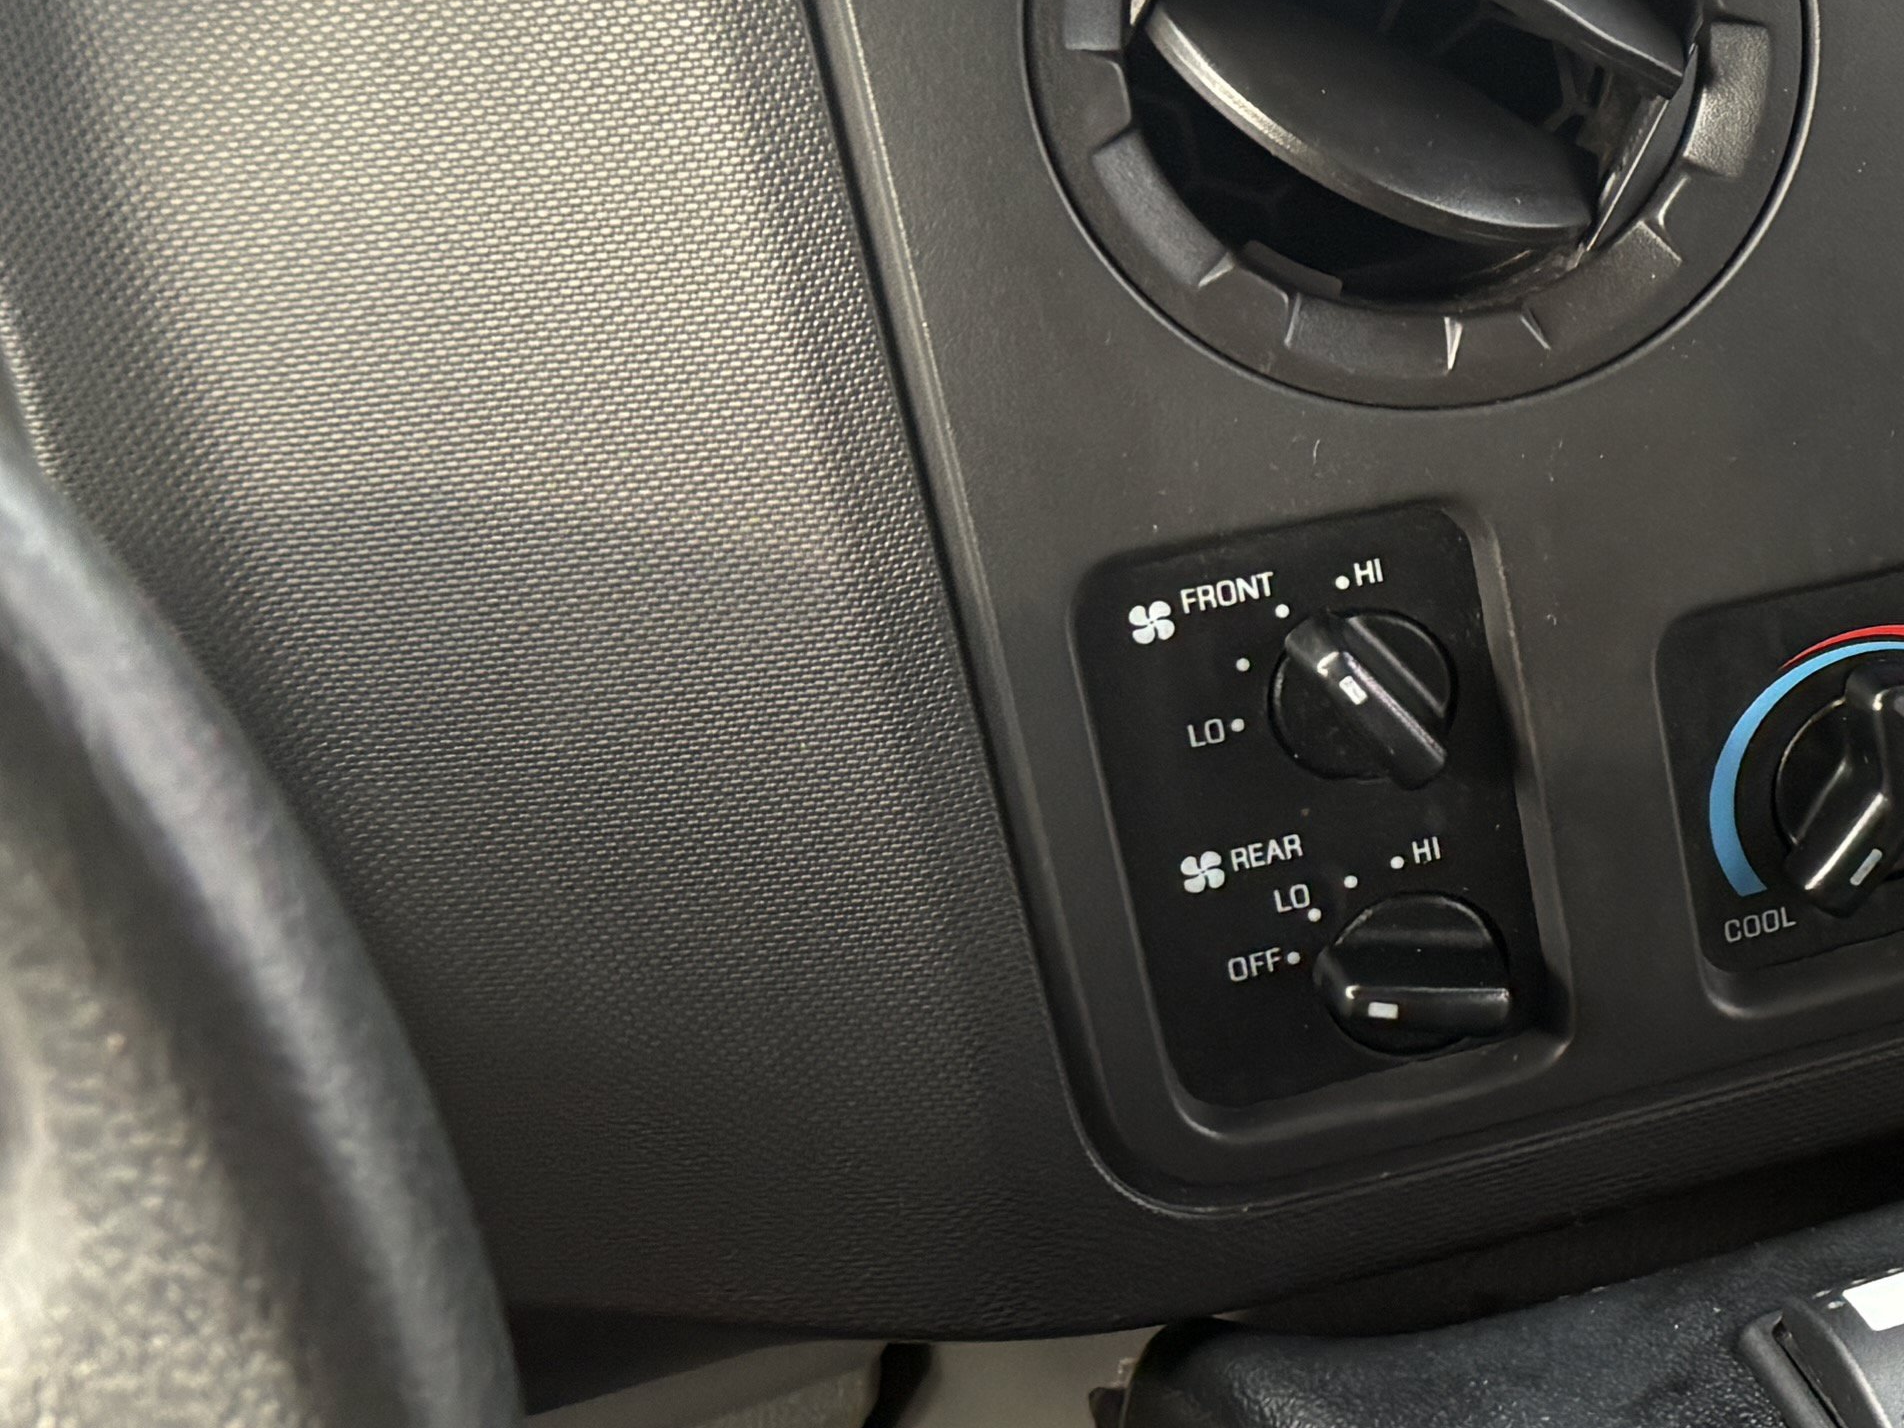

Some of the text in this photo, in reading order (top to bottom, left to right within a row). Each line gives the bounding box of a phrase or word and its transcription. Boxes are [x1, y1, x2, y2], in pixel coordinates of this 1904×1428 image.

[1353, 558, 1384, 587] HI
[1180, 571, 1275, 615] FRONT
[1187, 718, 1225, 748] LO
[1230, 834, 1303, 872] REAR
[1411, 836, 1441, 864] HI
[1273, 883, 1311, 914] LO
[1724, 906, 1797, 943] COOL
[1227, 947, 1281, 982] OFF
